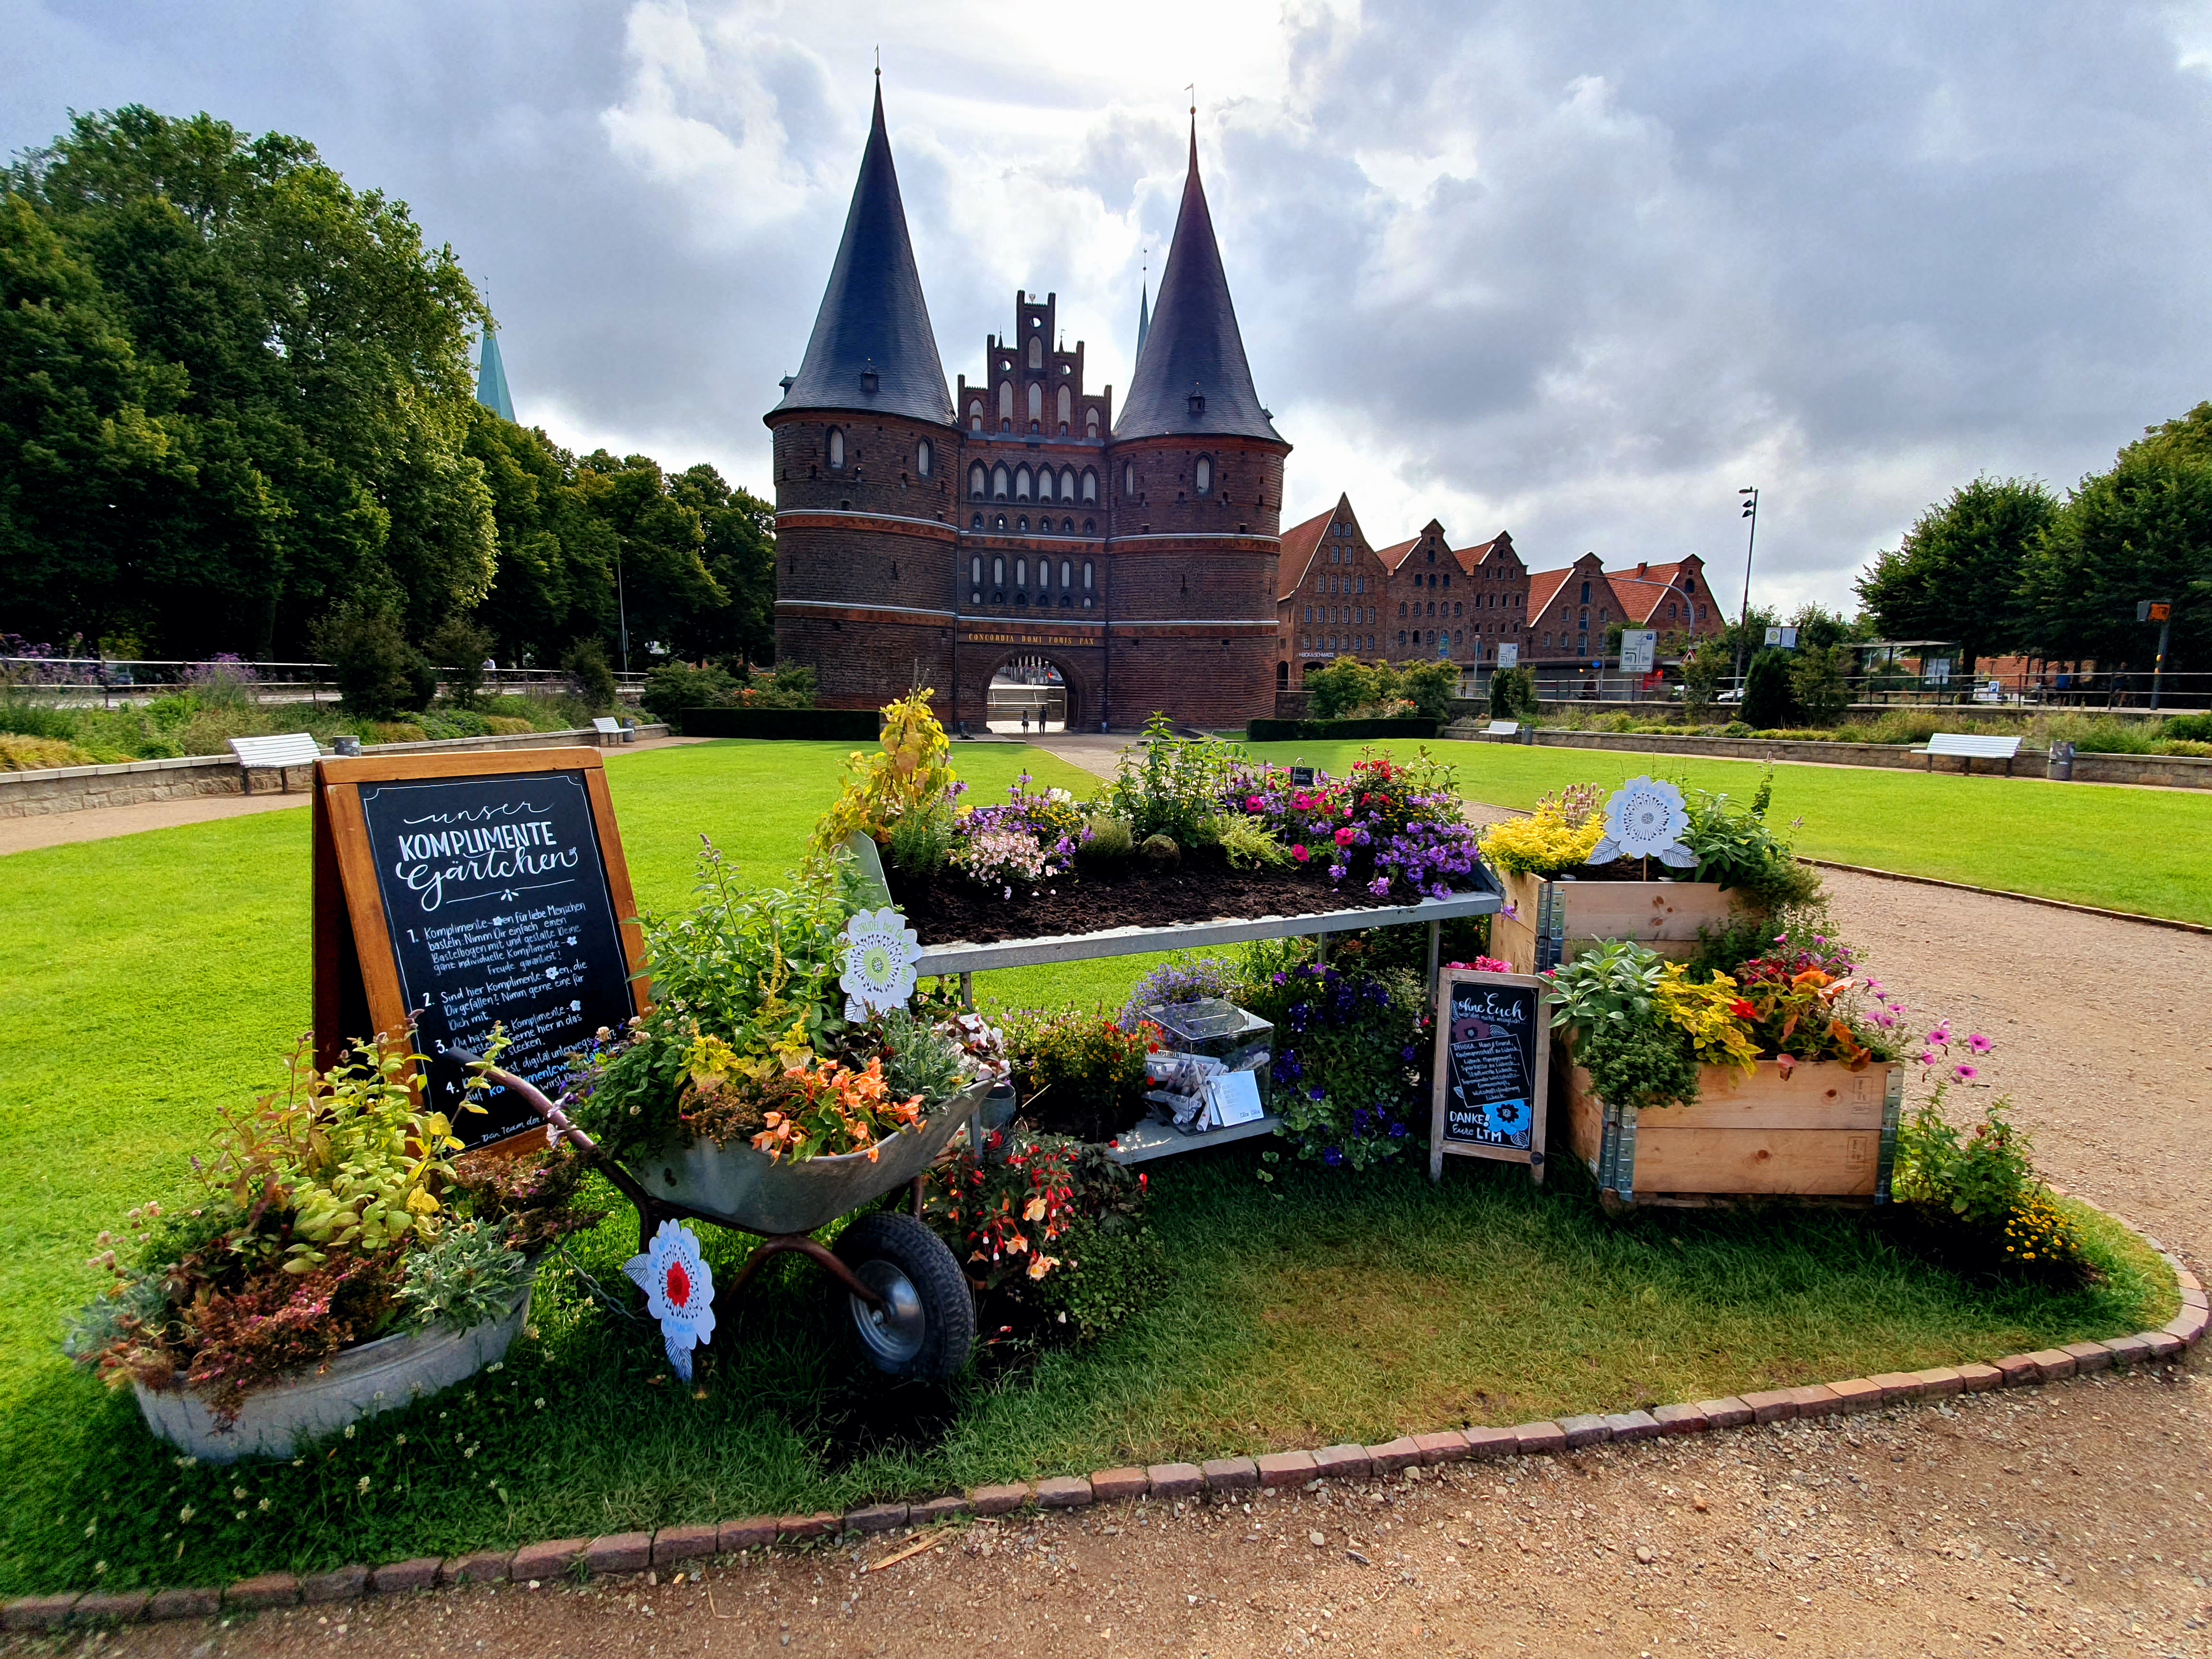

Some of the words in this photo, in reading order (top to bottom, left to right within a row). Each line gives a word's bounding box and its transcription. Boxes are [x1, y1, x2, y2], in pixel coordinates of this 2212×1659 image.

[968, 633, 1014, 642] CONCORDIA
[1022, 635, 1042, 643] DOMI
[1049, 636, 1072, 644] FORIS
[403, 801, 555, 824] unser
[398, 821, 557, 862] KOMPLIMENTE
[396, 846, 578, 912] Gärtchen
[407, 928, 419, 943] 1.
[515, 911, 528, 924] für
[528, 908, 546, 920] liebe
[547, 902, 586, 916] Menschen
[427, 937, 464, 952] basteln:
[464, 933, 493, 944] Nimm
[493, 927, 506, 939] Dir
[508, 922, 538, 936] einfach
[544, 917, 567, 927] einen
[431, 945, 487, 963] Bastelbogen
[488, 940, 505, 951] mit
[506, 935, 522, 947] und
[524, 930, 556, 945] gestalte
[557, 924, 581, 936] Deine
[854, 921, 881, 936] STRUDEL
[883, 919, 895, 933] bist
[901, 942, 912, 955] der
[433, 962, 456, 976] ganz
[458, 951, 505, 969] individuelle
[488, 961, 516, 975] Freude
[422, 992, 435, 1007] 2.
[441, 987, 464, 1003] Sind
[465, 986, 484, 997] hier
[573, 959, 588, 970] die
[444, 1004, 458, 1016] Dir
[459, 994, 499, 1016] gefallen?
[501, 989, 528, 1002] Nimm
[529, 982, 553, 998] gerne
[554, 977, 571, 987] eine
[572, 973, 584, 986] für
[1458, 997, 1485, 1012] ohne
[1484, 992, 1527, 1021] Euch
[448, 1017, 469, 1031] Dich
[471, 1010, 492, 1023] mit.
[507, 1029, 536, 1044] Gerne
[537, 1022, 554, 1034] hier
[556, 1020, 564, 1028] in
[565, 1014, 582, 1025] das
[435, 1039, 448, 1054] 3.
[467, 1029, 486, 1044] hast
[508, 1038, 545, 1056] stecken.
[446, 1082, 459, 1094] 4.
[523, 1050, 551, 1069] digital
[551, 1037, 592, 1059] unterwegs
[540, 1075, 563, 1091] wirst
[501, 1121, 526, 1135] Team
[527, 1116, 540, 1125] der
[1450, 1111, 1490, 1127] DANKE!
[1452, 1123, 1474, 1135] Eure
[1477, 1127, 1501, 1142] LTM
